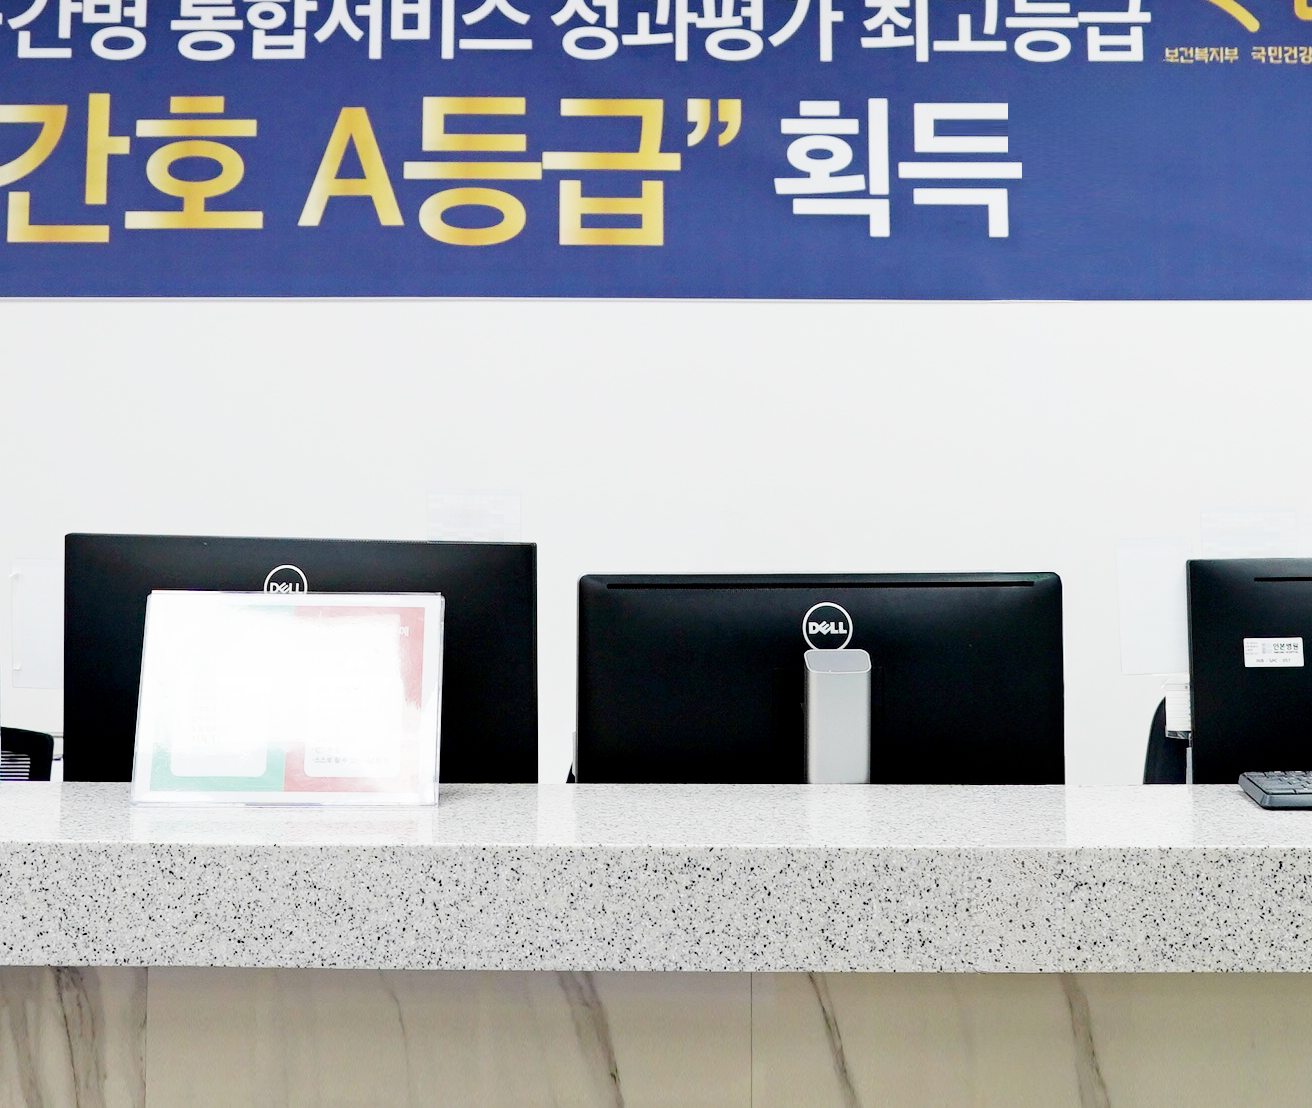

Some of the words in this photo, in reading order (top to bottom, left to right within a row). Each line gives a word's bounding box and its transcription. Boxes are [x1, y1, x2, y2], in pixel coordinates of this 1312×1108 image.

[1163, 46, 1239, 64] 보건복지부
[773, 97, 1023, 239] 획득
[270, 582, 304, 594] DELL
[808, 620, 848, 635] DELL
[1273, 643, 1298, 651] 인본병원
